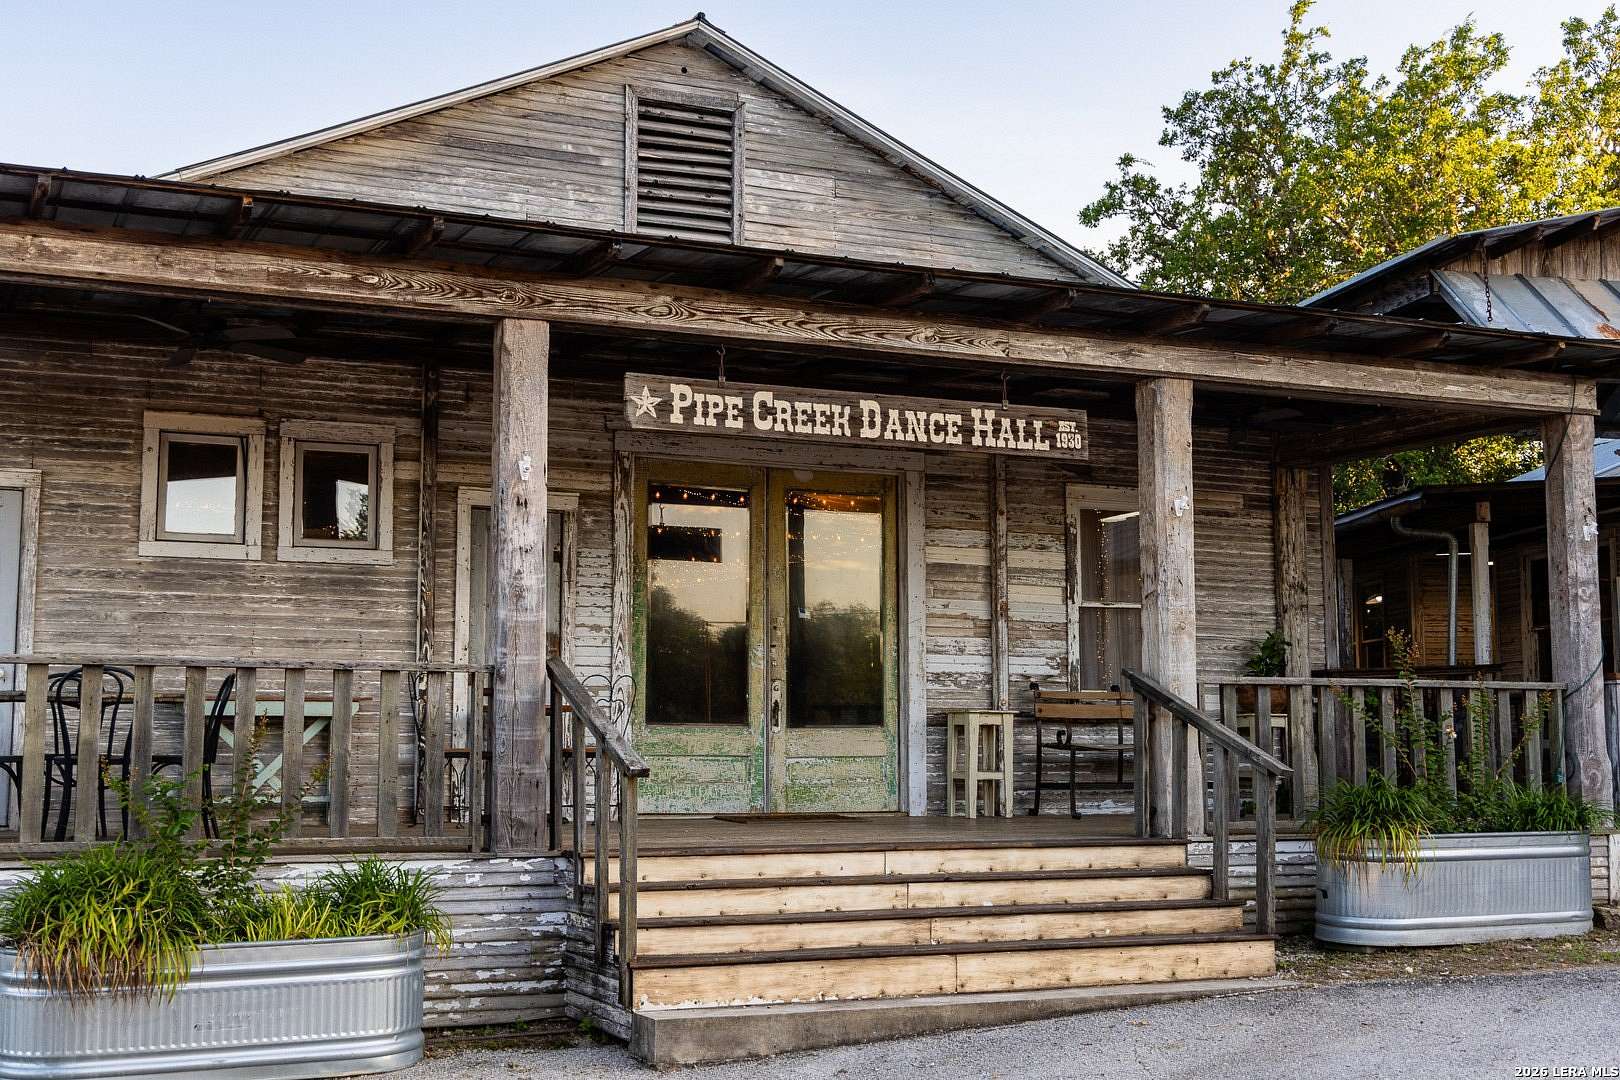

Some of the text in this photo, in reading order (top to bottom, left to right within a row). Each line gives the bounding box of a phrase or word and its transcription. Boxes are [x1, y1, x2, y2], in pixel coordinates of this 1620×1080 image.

[670, 383, 1050, 451] PIPE CREEK DANCE HALL
[1055, 432, 1082, 450] 1930
